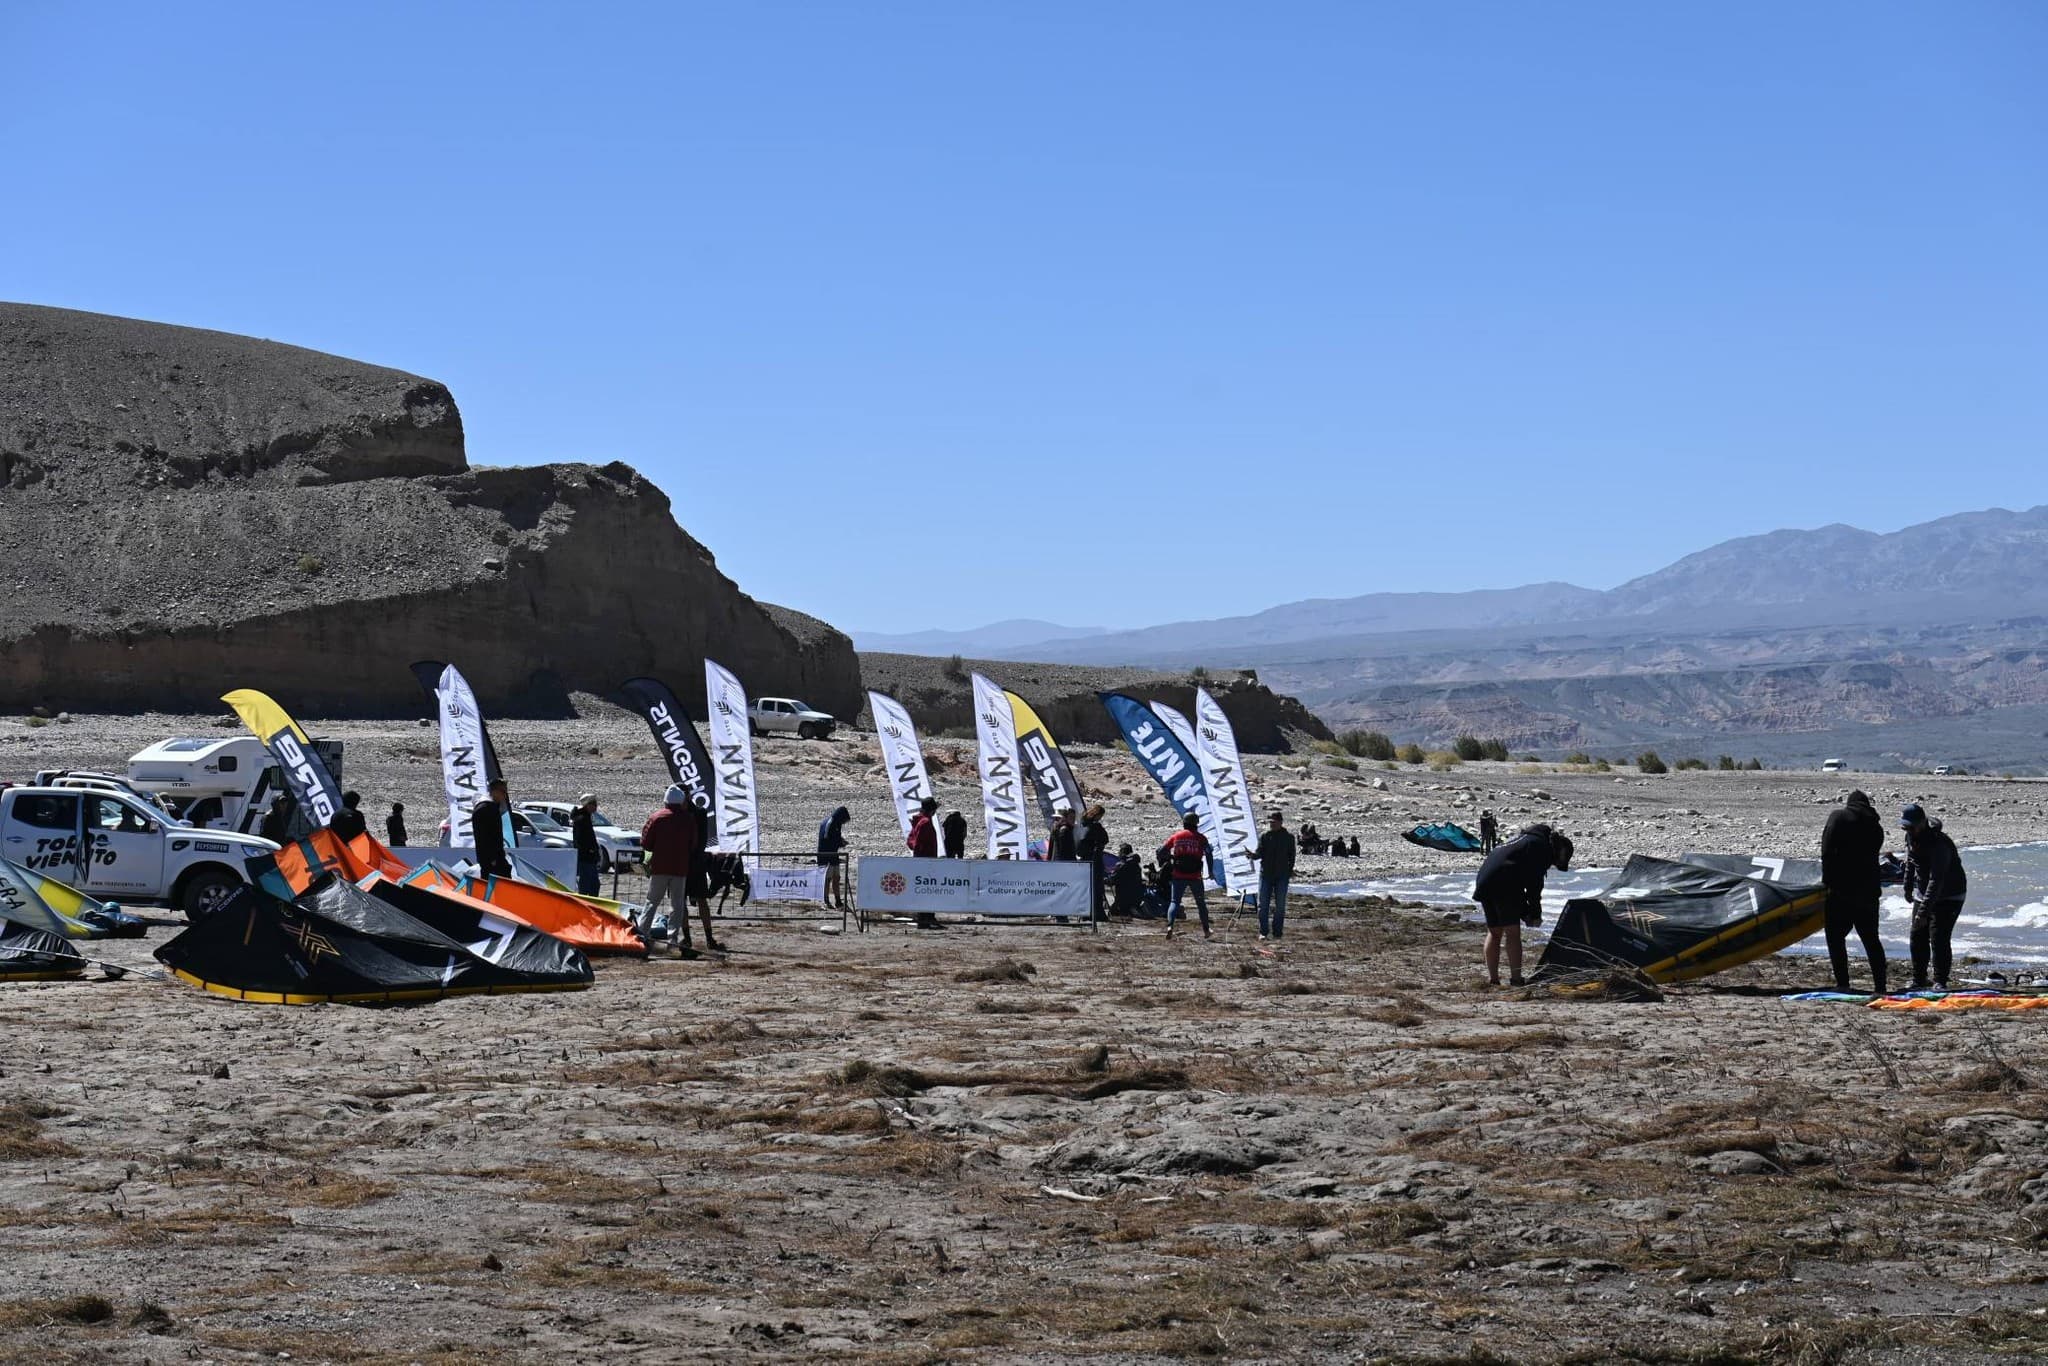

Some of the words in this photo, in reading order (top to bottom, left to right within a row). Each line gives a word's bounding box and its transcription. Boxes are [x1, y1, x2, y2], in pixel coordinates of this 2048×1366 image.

[1130, 721, 1185, 782] KITE
[451, 745, 479, 837] IVIAN
[895, 762, 922, 814] IAN
[987, 755, 1019, 861] IVIAN
[1210, 766, 1256, 877] LIVIAN
[765, 879, 808, 888] LIVIAN
[914, 875, 937, 886] San
[940, 876, 970, 887] Juan
[914, 886, 955, 896] Gobierno
[987, 879, 1025, 887] Ministerio
[987, 887, 1016, 895] Cultura
[1016, 888, 1023, 896] y
[1023, 888, 1056, 896] Deporte
